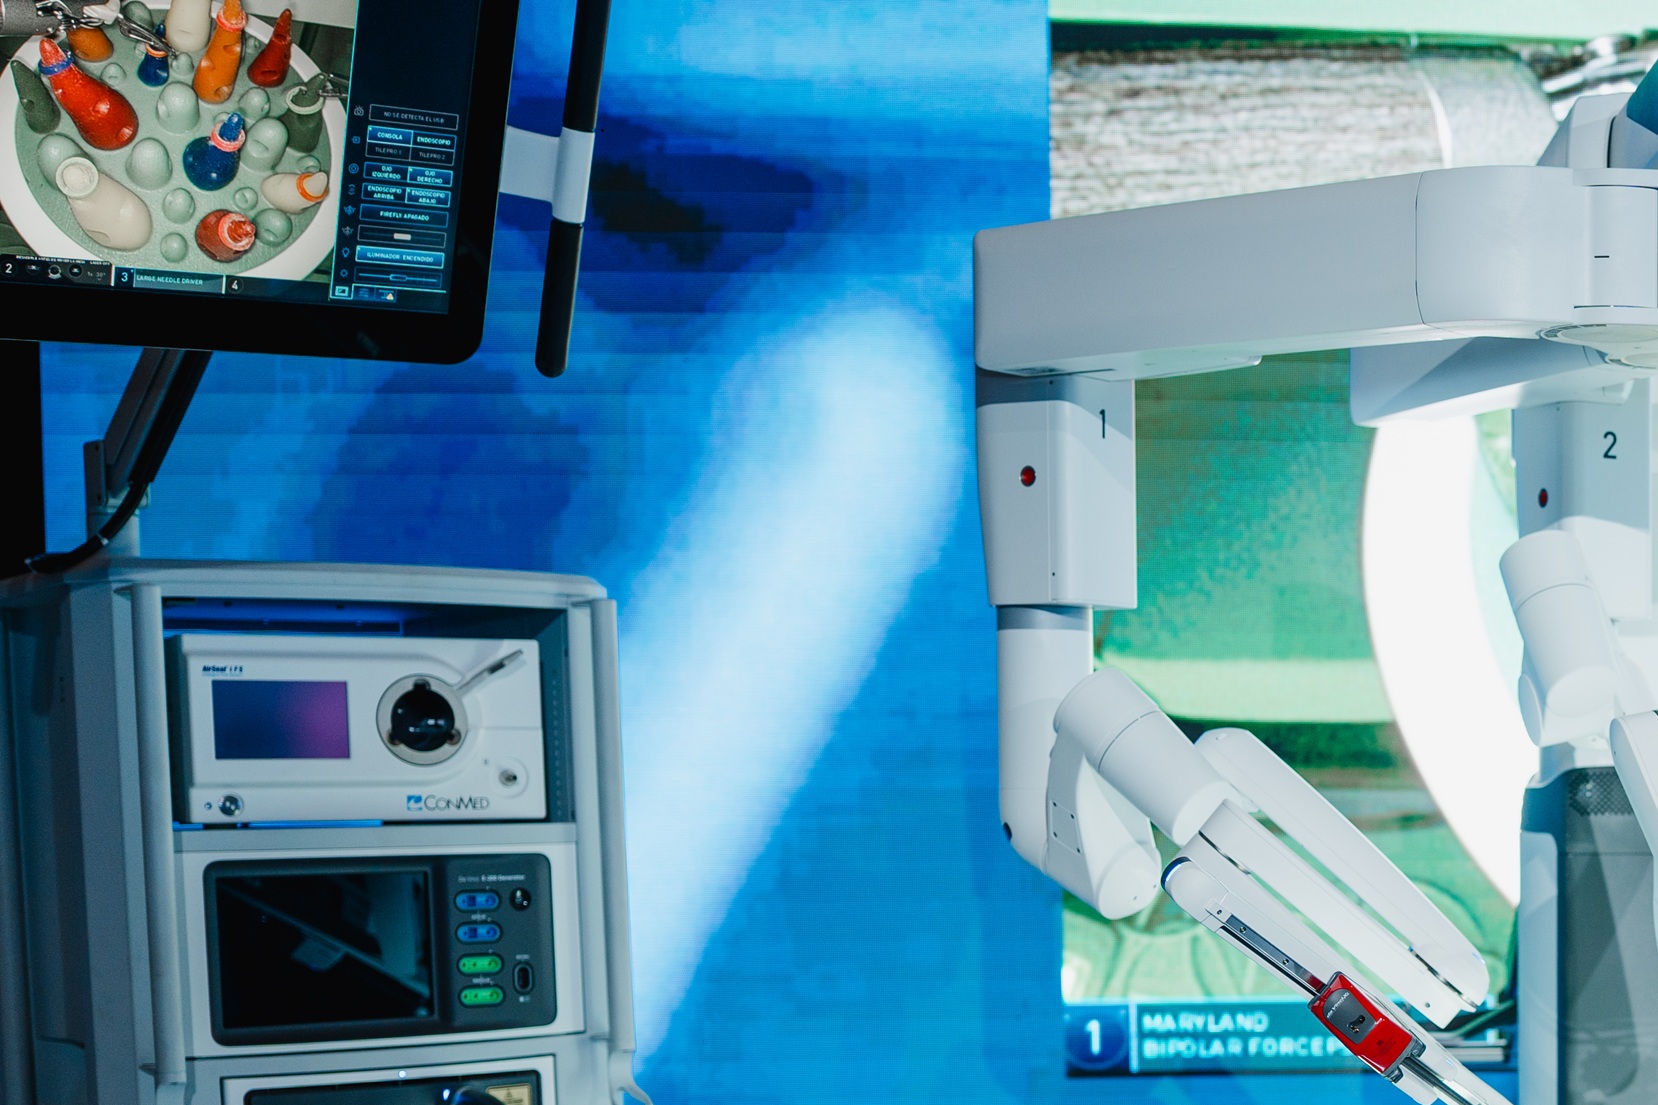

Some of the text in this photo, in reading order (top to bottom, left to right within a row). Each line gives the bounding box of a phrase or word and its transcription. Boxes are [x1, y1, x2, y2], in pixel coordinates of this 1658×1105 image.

[377, 132, 451, 146] CONSOLA ENDOSCOPIO
[417, 176, 442, 184] DERECHO
[368, 186, 402, 194] ENDOSCOPIO
[412, 190, 446, 198] ENDOSCOPIO
[404, 213, 430, 221] APAGADO
[366, 252, 434, 262] ILUMINADOR ENCENDIDO
[5, 263, 12, 274] 2
[120, 272, 128, 282] 3
[156, 276, 180, 284] NEEDLE
[182, 277, 204, 285] DRIVER
[232, 280, 238, 290] 4
[1098, 408, 1106, 439] 1
[1603, 431, 1617, 460] 2
[1142, 1011, 1269, 1033] MARYLAND
[1085, 1019, 1101, 1055] 1
[1142, 1037, 1243, 1058] BIPOLAR
